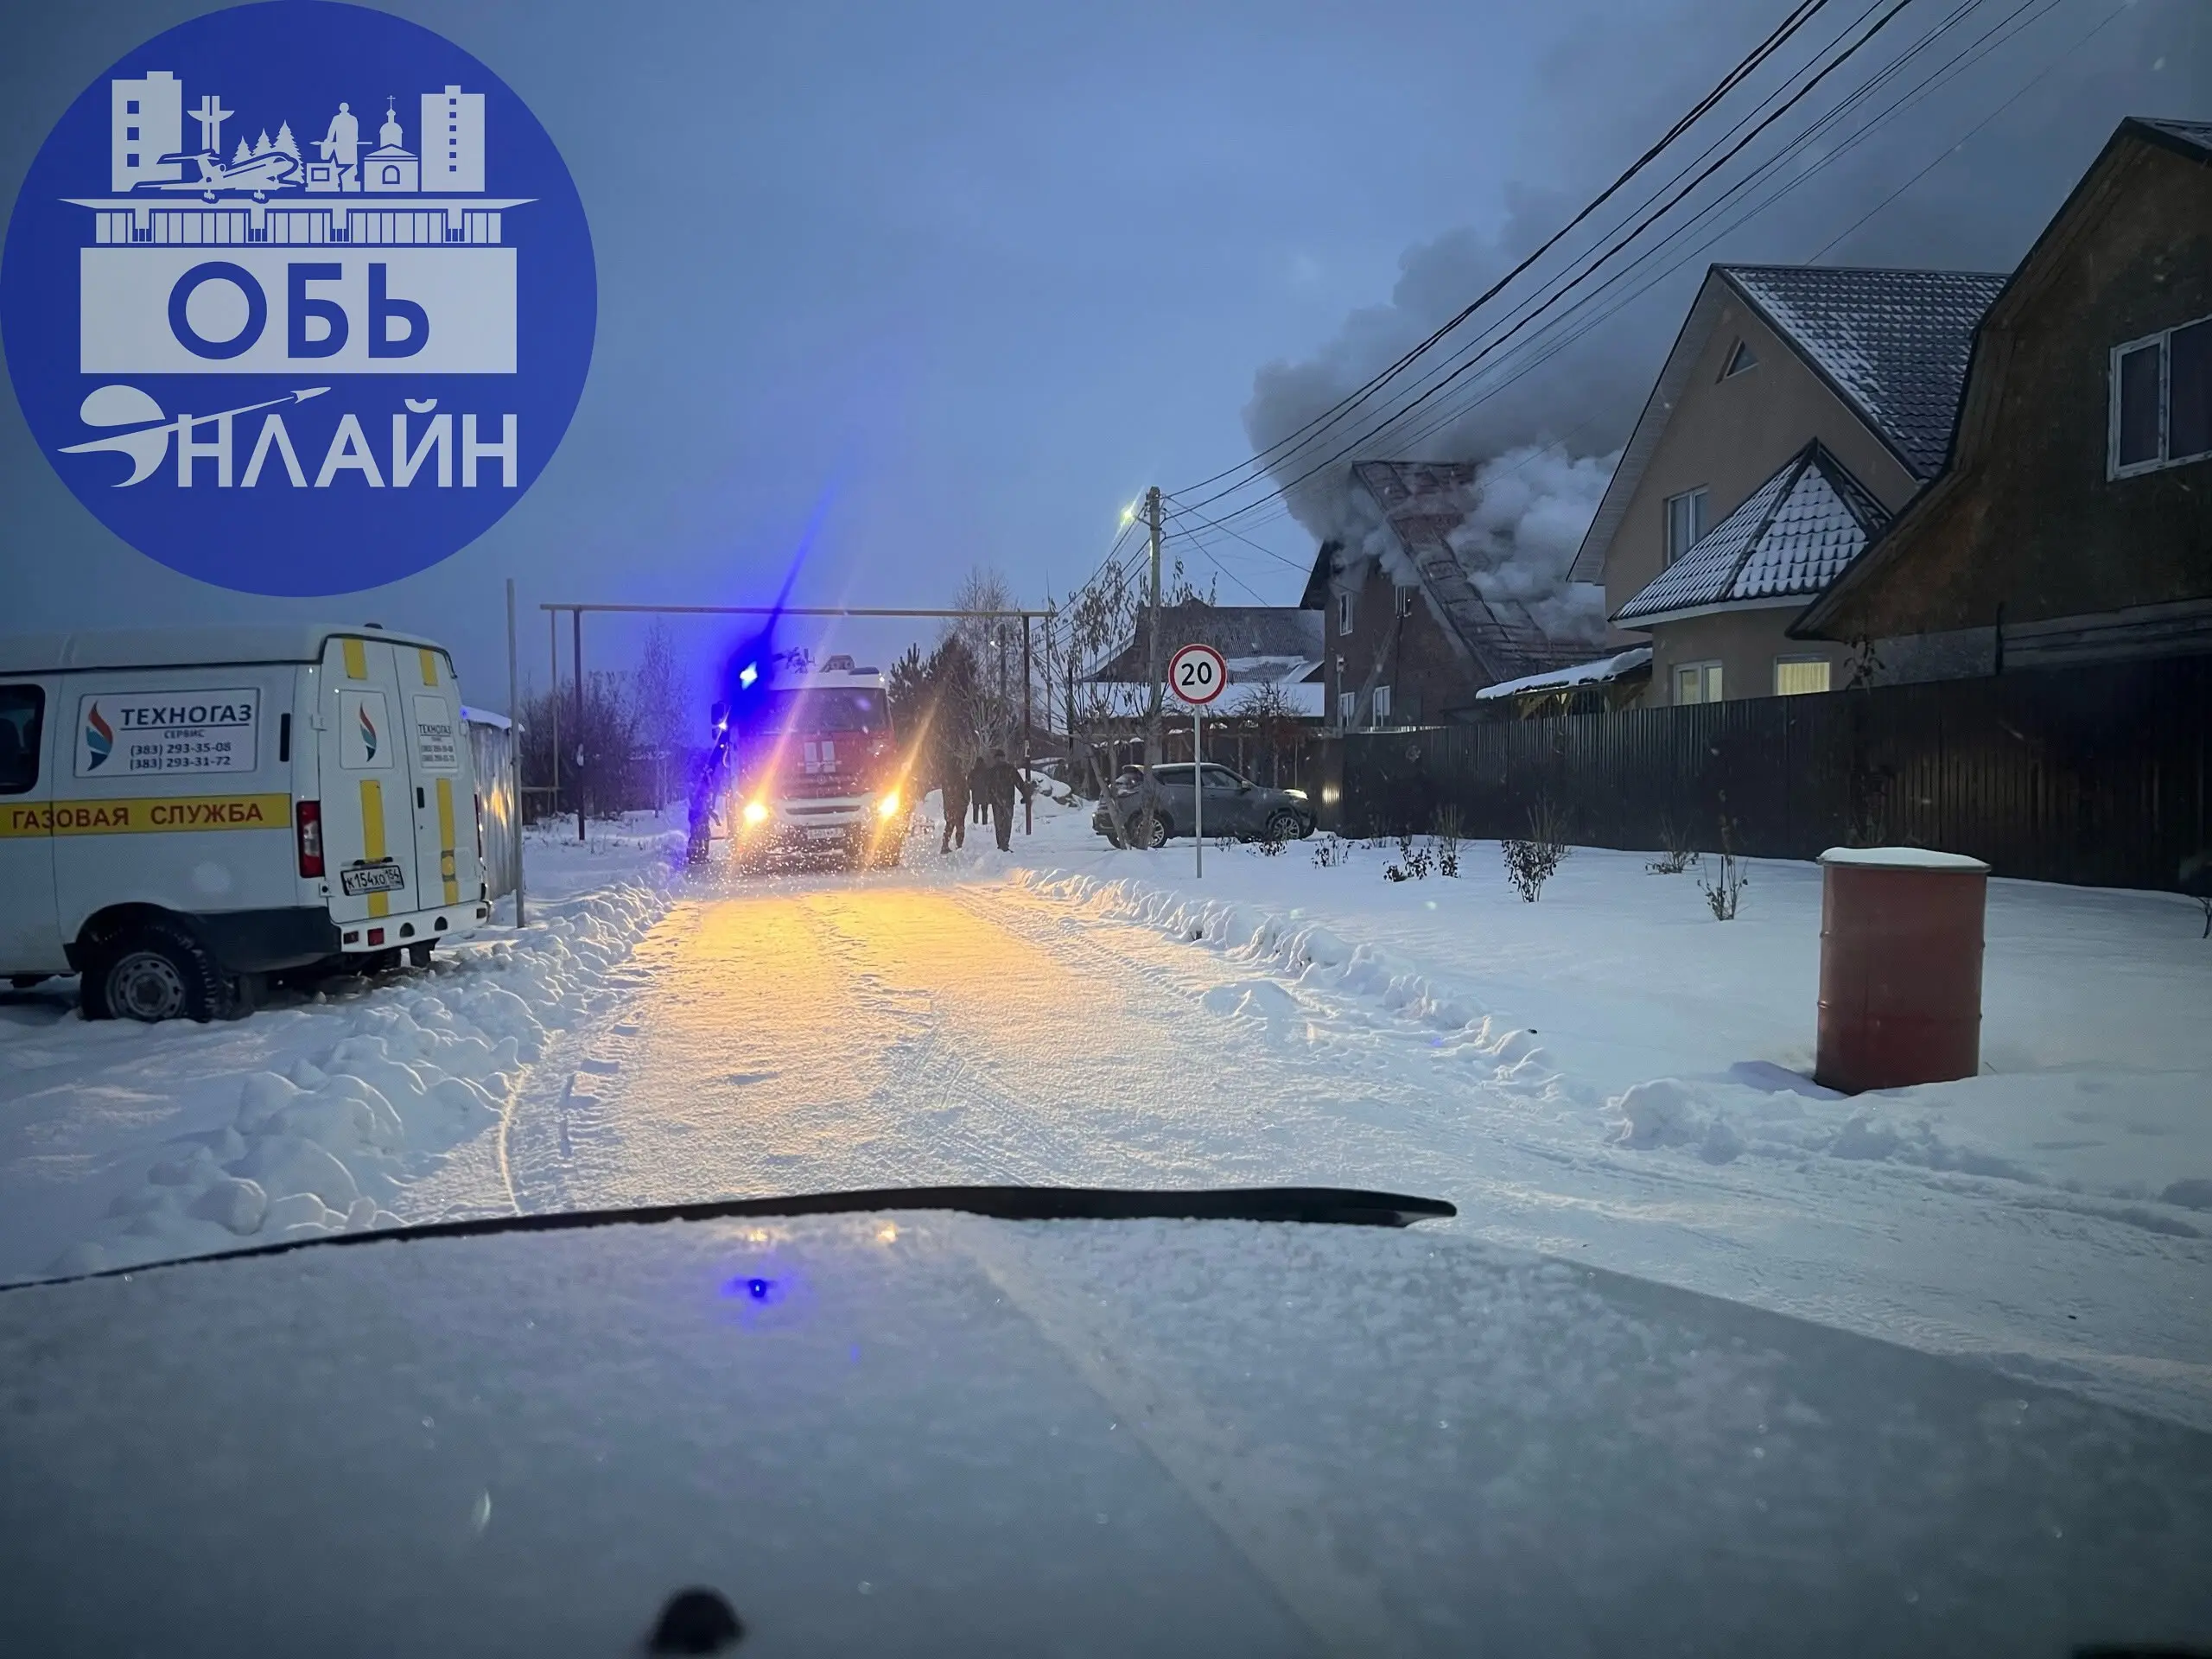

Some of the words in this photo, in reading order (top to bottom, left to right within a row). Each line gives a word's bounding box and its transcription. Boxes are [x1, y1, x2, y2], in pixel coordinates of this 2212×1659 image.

[1181, 662, 1212, 686] 20
[121, 704, 252, 726] ТЕХНОГАЗ
[163, 729, 207, 740] СЕРВИС
[130, 744, 163, 757] (383)
[167, 742, 232, 754] 293-35-08
[130, 758, 162, 770] (383)
[167, 756, 231, 768] 293-31-72
[12, 807, 130, 830] ГАЗОВАЯ
[150, 803, 264, 825] СЛУЖБА
